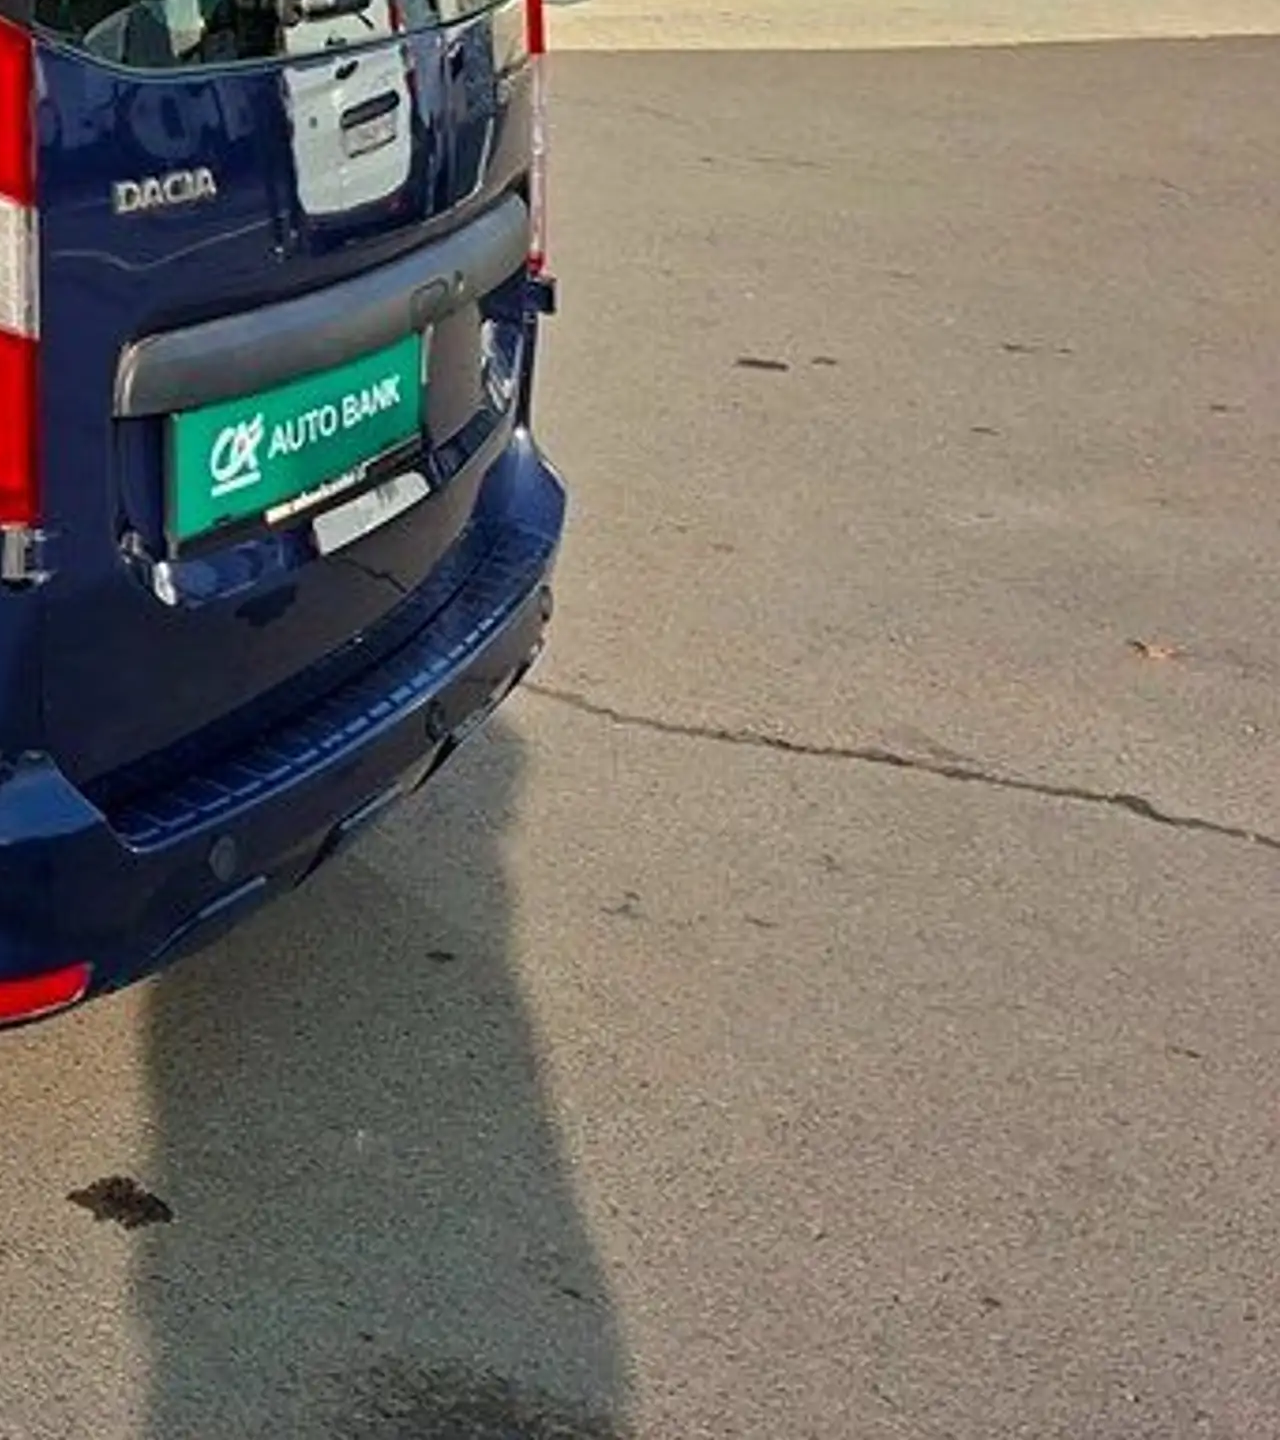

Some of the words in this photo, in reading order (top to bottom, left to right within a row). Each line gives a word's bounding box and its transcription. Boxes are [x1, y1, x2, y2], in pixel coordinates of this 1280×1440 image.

[112, 166, 217, 214] DACIA
[268, 405, 337, 459] AUTO
[342, 374, 401, 428] BANK
